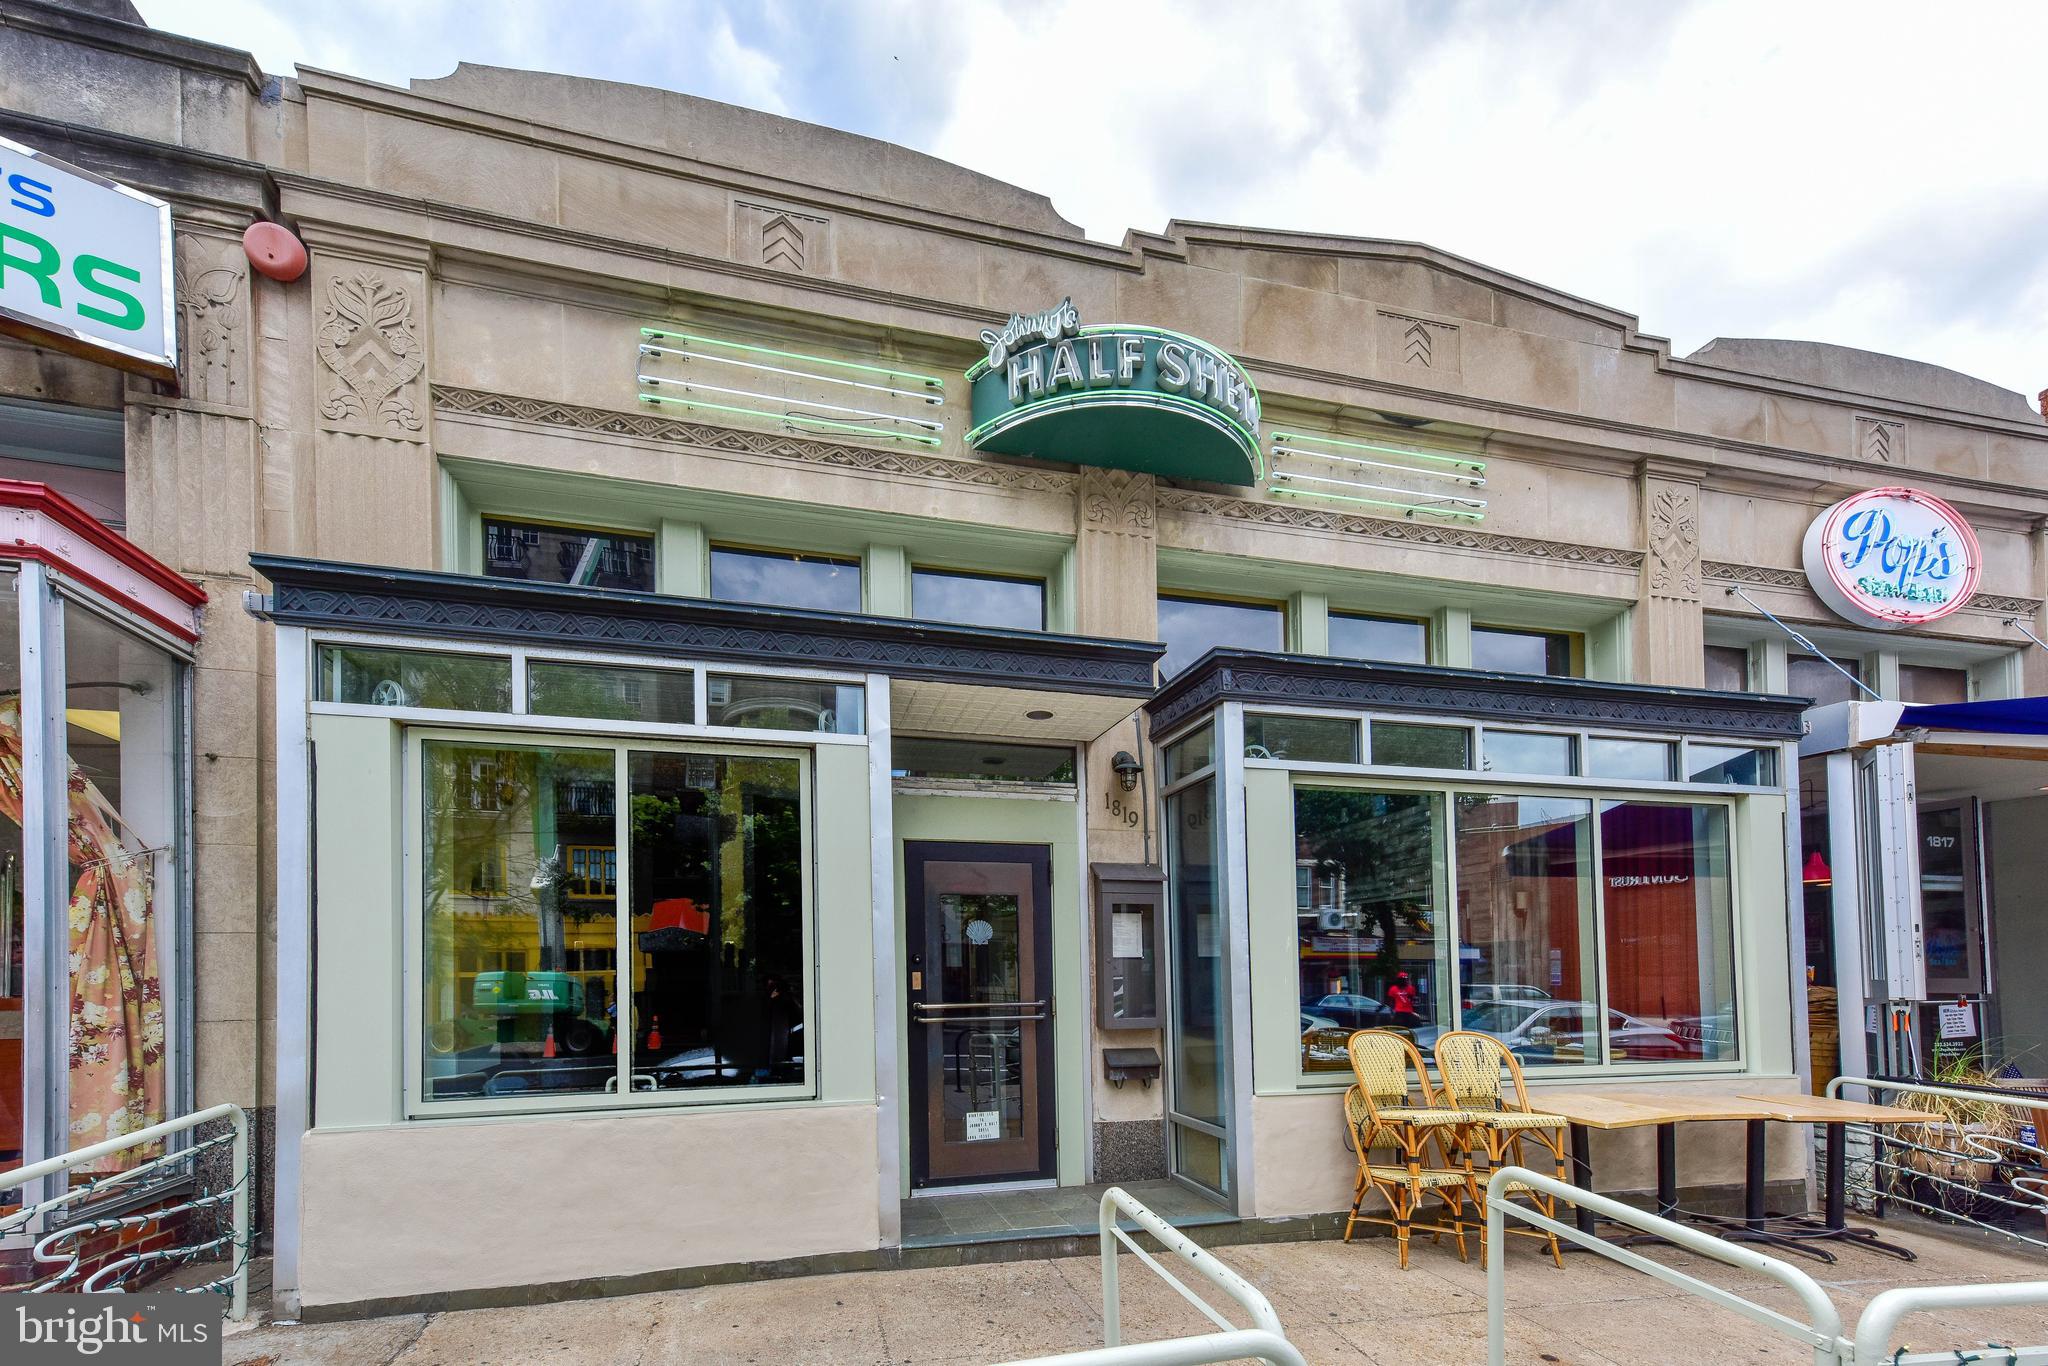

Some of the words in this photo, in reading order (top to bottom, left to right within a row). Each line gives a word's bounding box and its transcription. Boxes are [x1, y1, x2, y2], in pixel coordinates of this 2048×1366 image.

[1007, 335, 1145, 406] HALF
[1104, 792, 1138, 828] 1819
[1926, 836, 1955, 848] 1817
